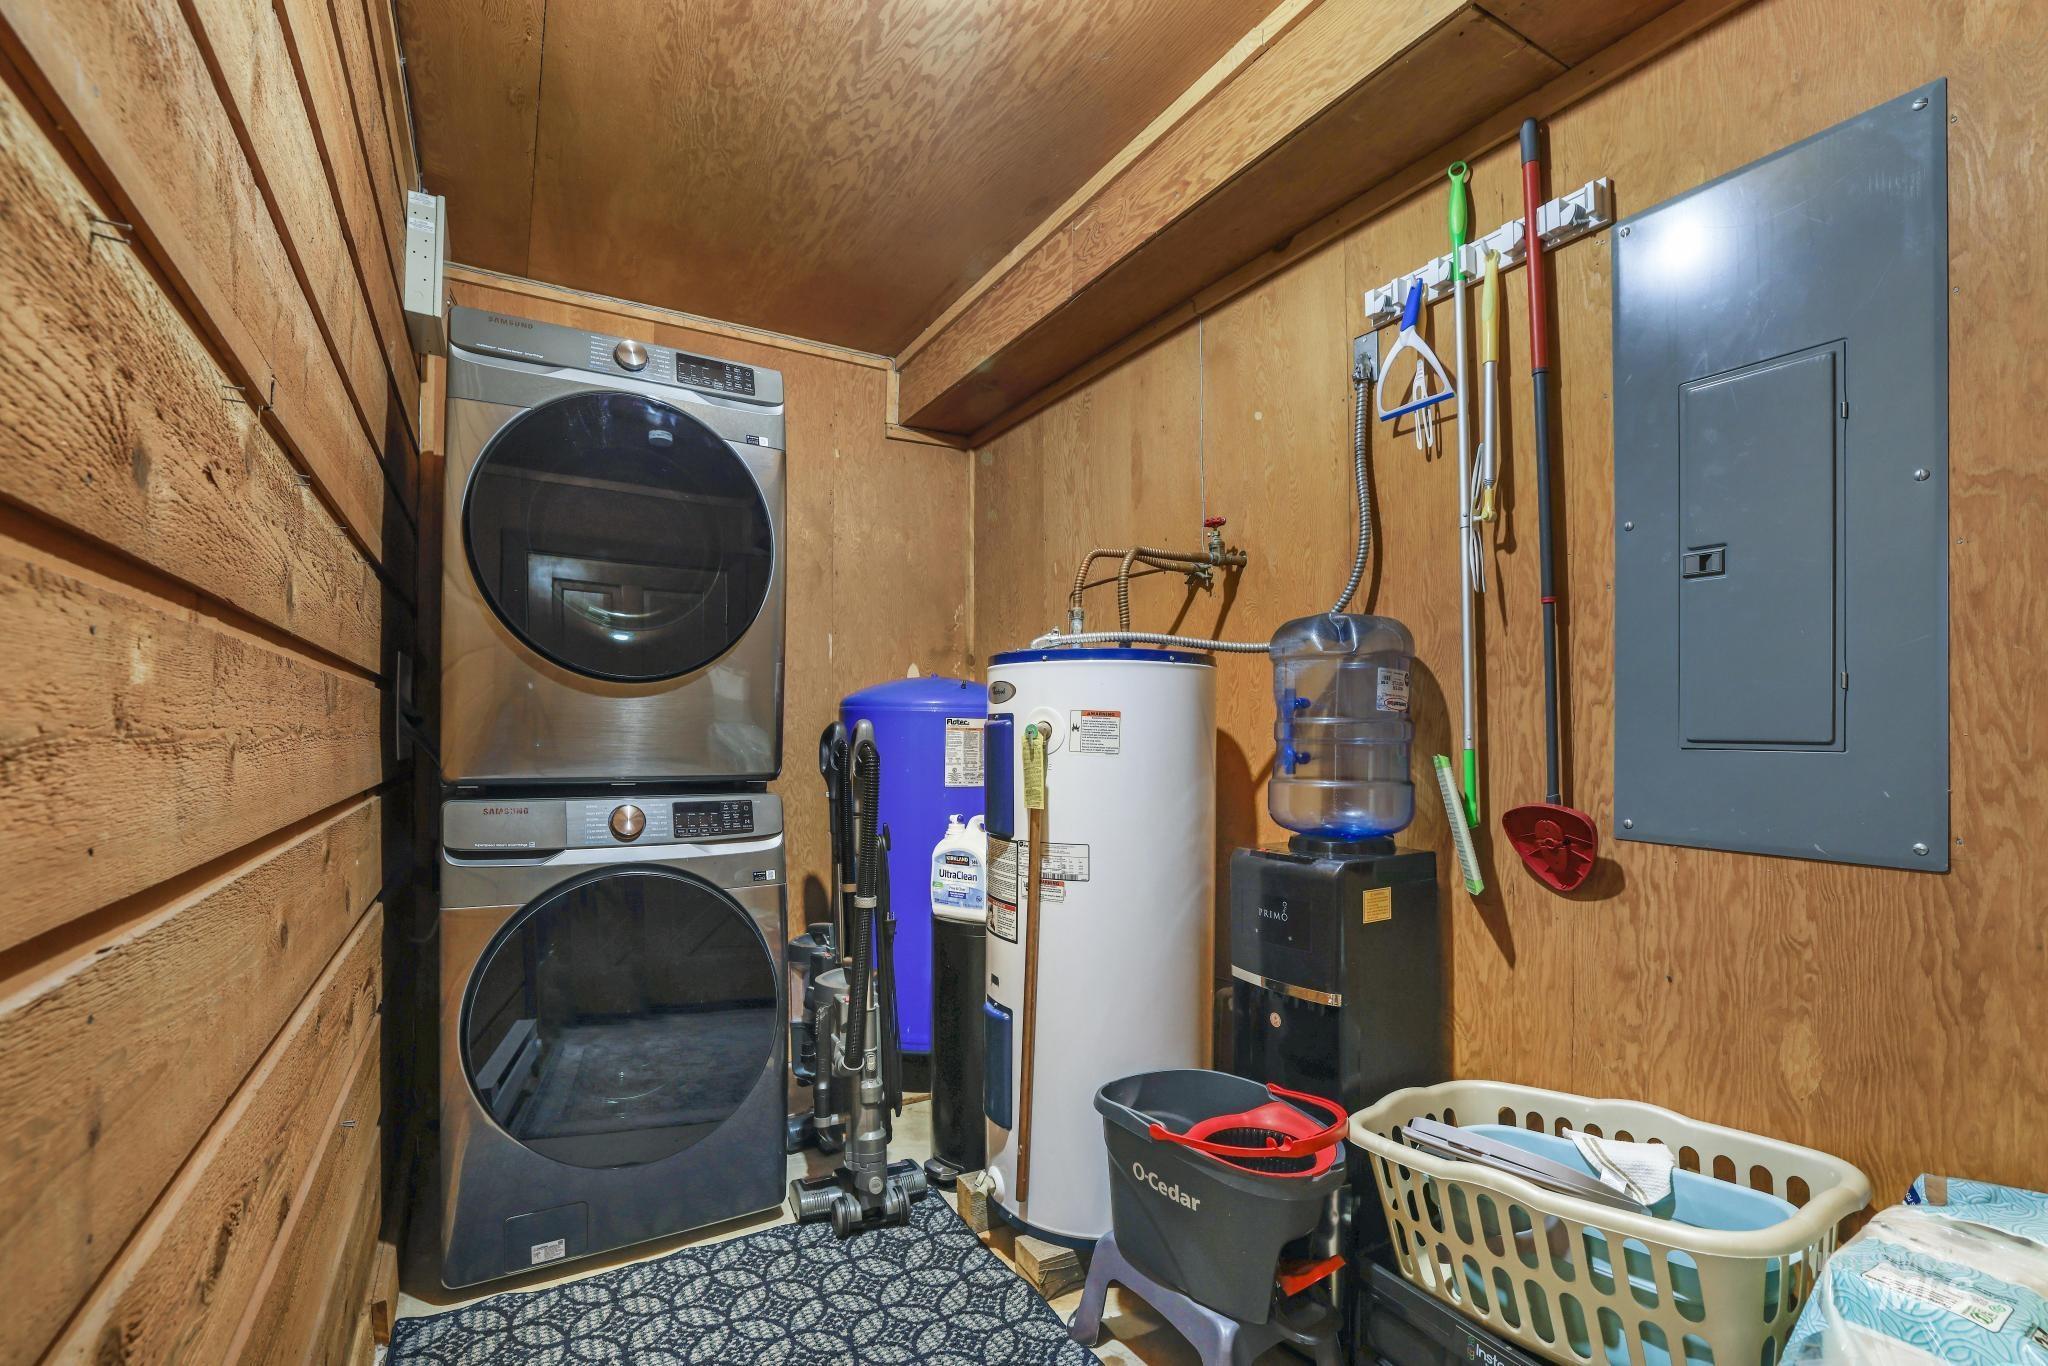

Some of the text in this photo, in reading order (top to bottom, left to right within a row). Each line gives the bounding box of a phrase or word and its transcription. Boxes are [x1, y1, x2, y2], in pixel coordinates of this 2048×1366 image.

[488, 316, 534, 330] SAMSUNG
[482, 807, 530, 816] SAMSUNG
[939, 868, 978, 881] UltraClean
[1257, 906, 1289, 922] PRIMO
[1132, 1161, 1201, 1212] O-Cedar
